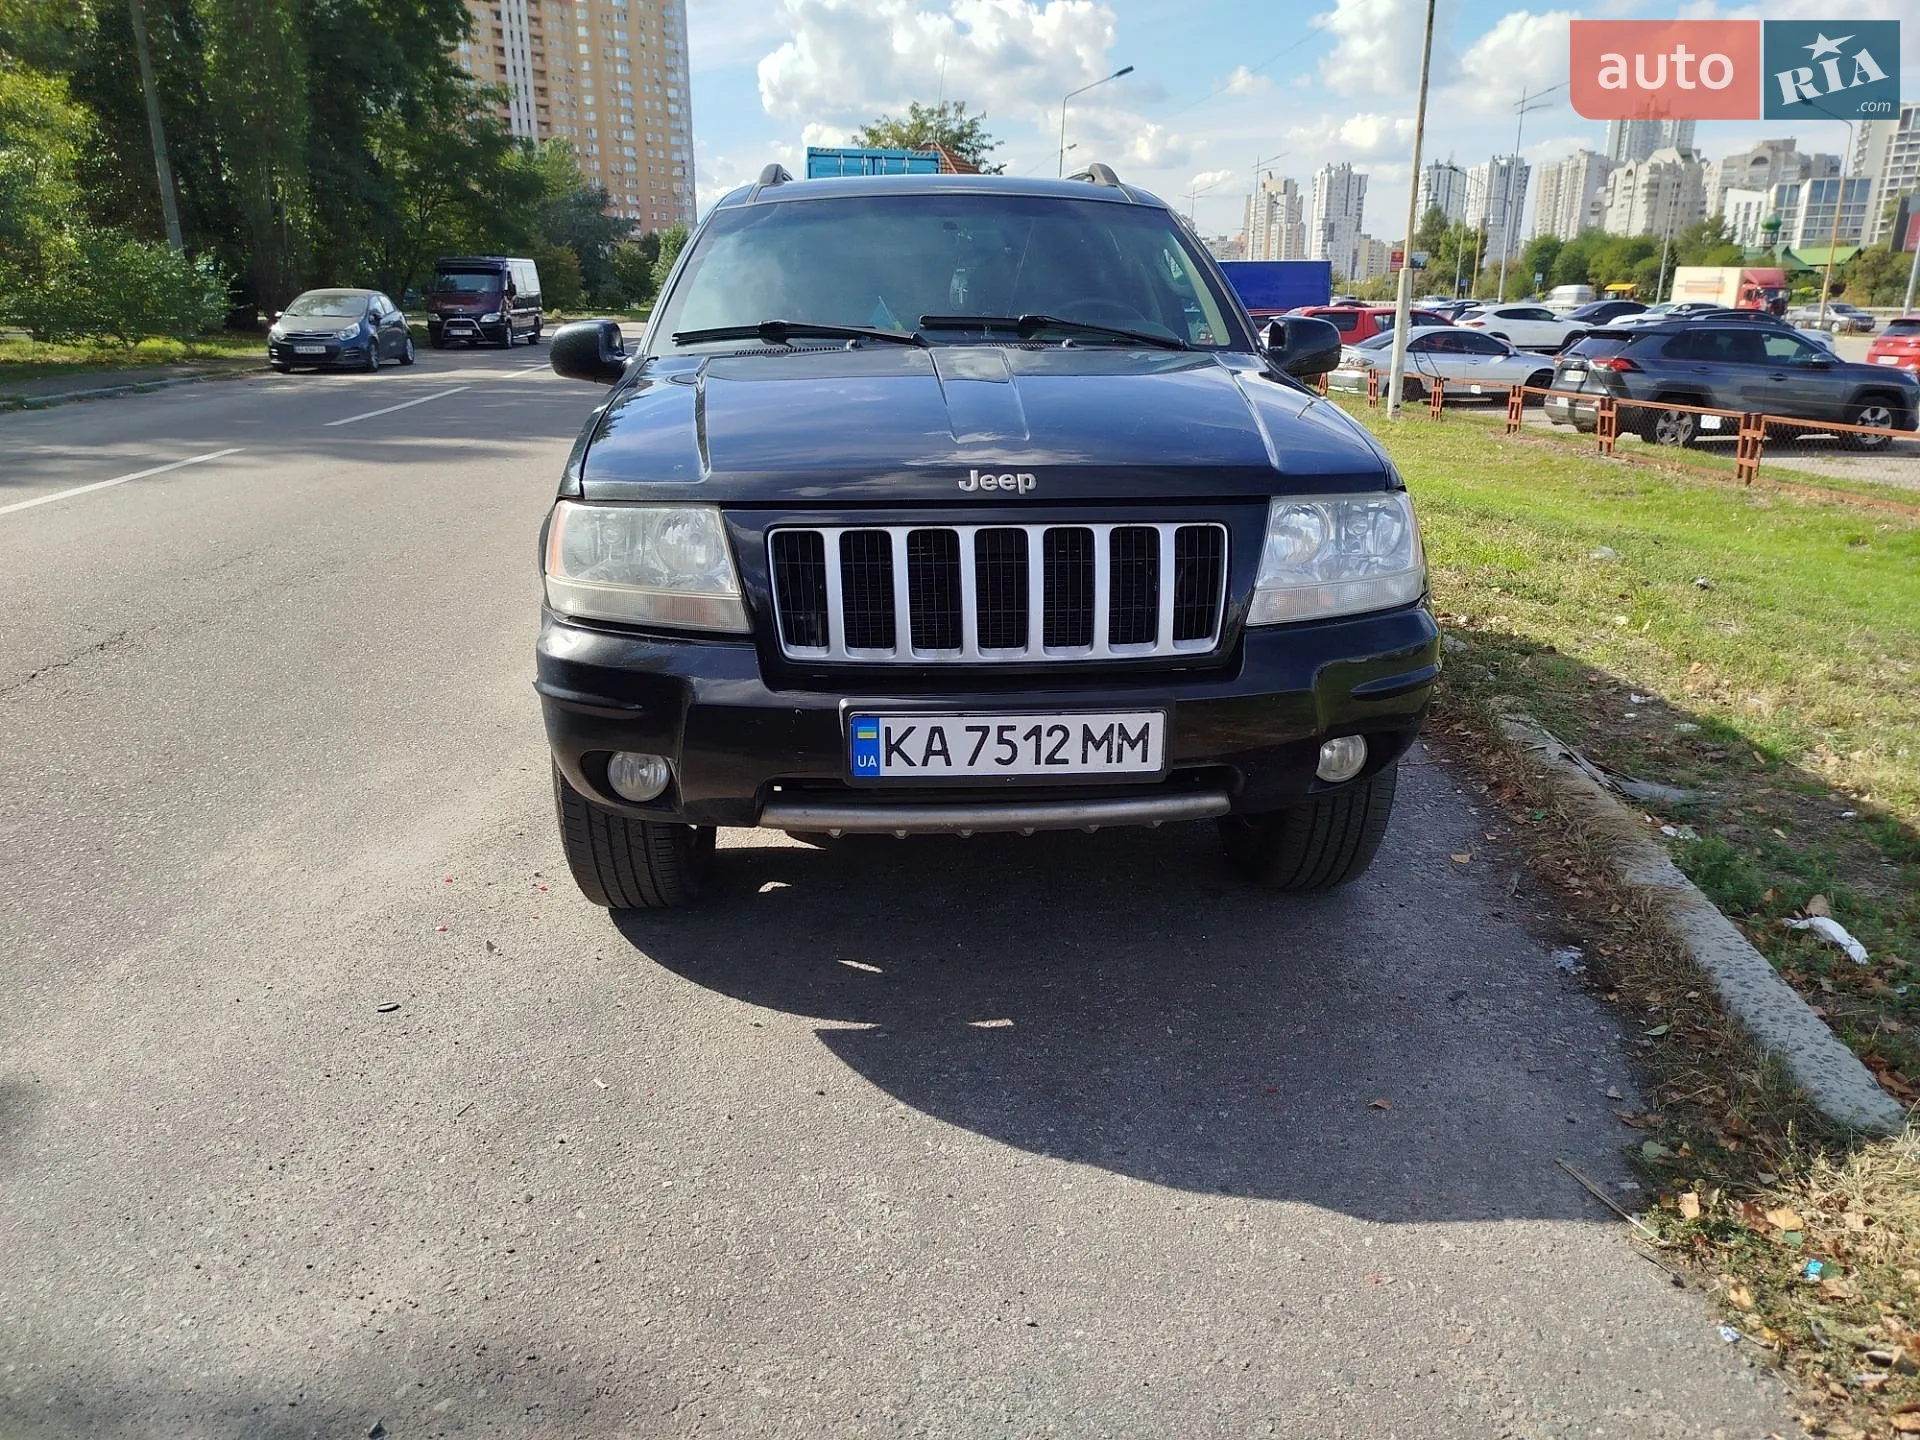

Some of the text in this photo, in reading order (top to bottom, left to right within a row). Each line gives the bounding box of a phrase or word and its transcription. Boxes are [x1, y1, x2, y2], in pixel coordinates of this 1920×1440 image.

[958, 469, 1037, 495] Jeep
[884, 722, 1150, 767] KA 7512 MM
[857, 755, 877, 768] UA
